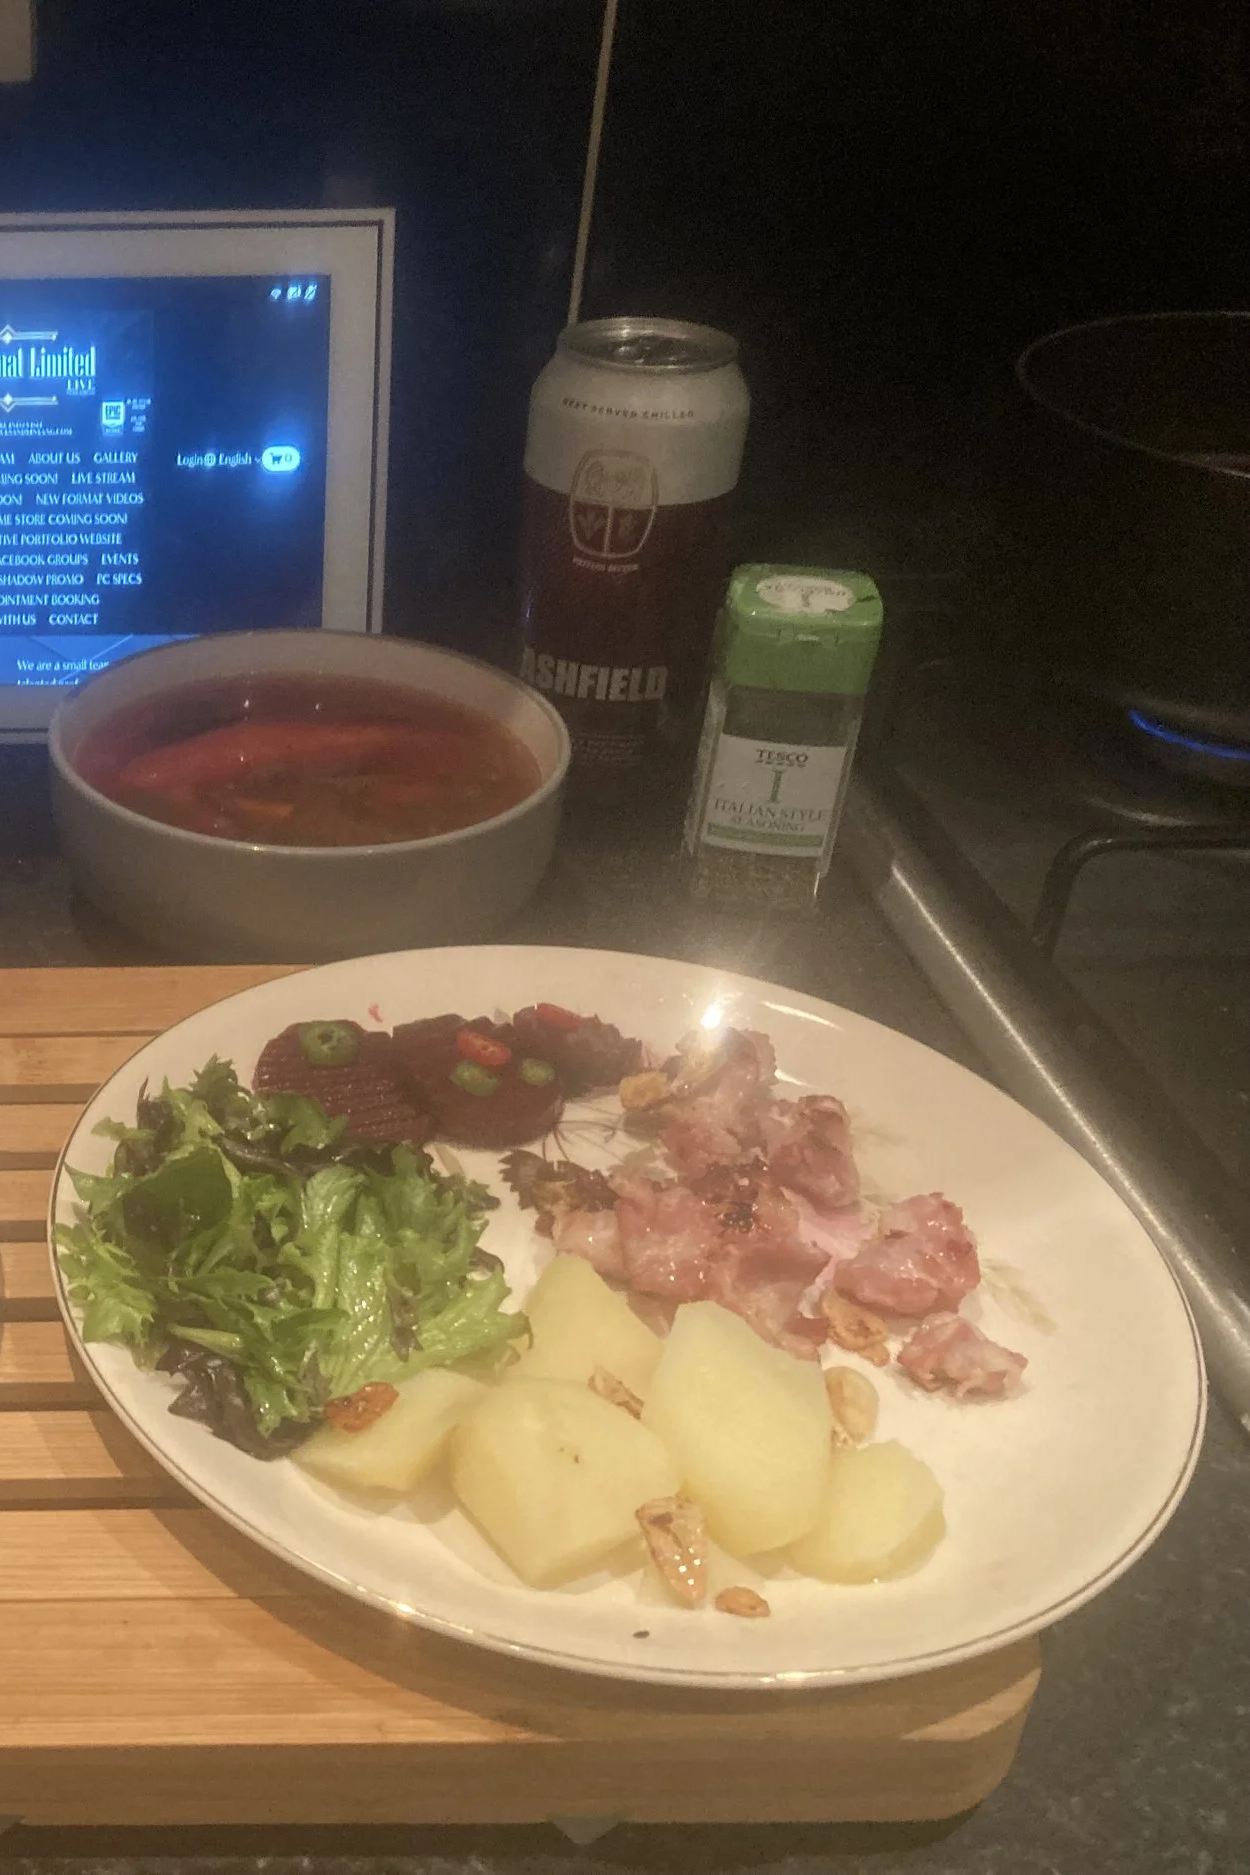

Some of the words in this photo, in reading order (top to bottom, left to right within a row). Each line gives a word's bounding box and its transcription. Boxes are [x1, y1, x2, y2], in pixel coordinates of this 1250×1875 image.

[30, 345, 96, 378] Limited
[643, 410, 695, 421] CHILLED
[28, 452, 63, 465] ABOUT
[65, 452, 81, 464] US
[93, 451, 139, 464] GALLERY
[177, 453, 204, 468] Login
[218, 452, 252, 468] English
[71, 472, 94, 485] LIVE
[95, 472, 136, 485] STREAM
[36, 492, 61, 505] NEW
[62, 492, 104, 504] FORMAT
[105, 492, 144, 504] VIDEOS
[14, 513, 47, 526] STORE
[48, 512, 93, 525] COMING
[20, 533, 78, 546] PORTFOLIO
[79, 532, 122, 546] WEBSITE
[47, 553, 88, 566] GROUPS
[101, 552, 139, 566] EVENTS
[45, 573, 84, 586] PROMO
[96, 573, 111, 585] PC
[112, 573, 142, 586] SPECS
[51, 593, 100, 606] BOOKING
[22, 613, 37, 626] US
[48, 613, 99, 626] CONTACT
[17, 659, 34, 671] We
[36, 661, 52, 671] are
[53, 661, 60, 671] a
[62, 658, 87, 670] small
[519, 645, 669, 702] ASHFIELD
[756, 748, 809, 764] TESCO
[714, 798, 776, 819] ITALIAN
[780, 808, 825, 822] STYLE
[731, 815, 805, 832] SEASONING
